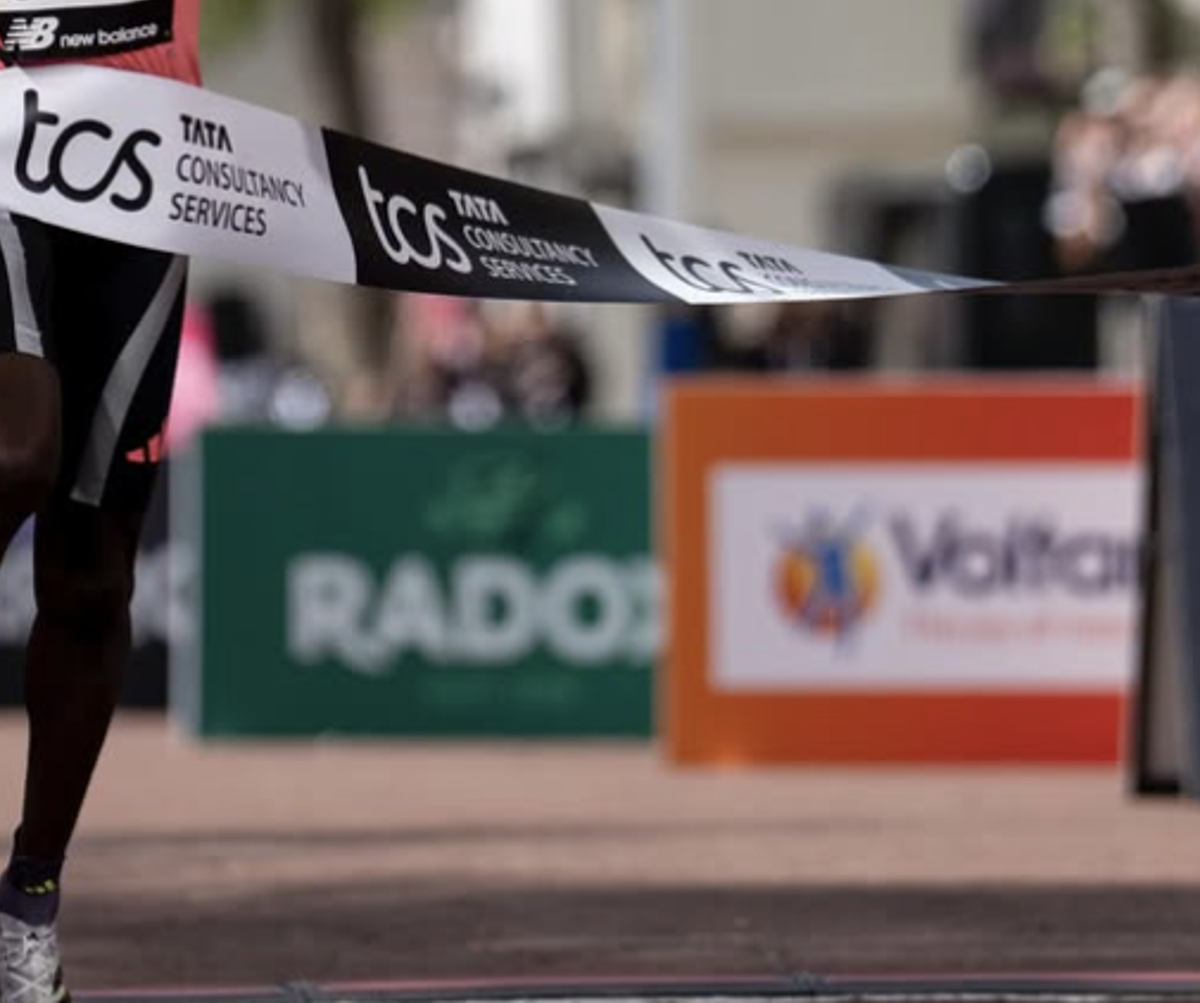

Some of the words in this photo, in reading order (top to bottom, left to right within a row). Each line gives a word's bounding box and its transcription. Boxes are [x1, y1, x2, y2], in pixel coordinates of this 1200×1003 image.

[60, 32, 96, 47] new
[97, 23, 158, 45] balance
[15, 89, 161, 211] tcs
[180, 114, 233, 153] TATA
[176, 154, 305, 207] CONSULTANCY
[169, 193, 267, 236] SERVICES
[358, 165, 473, 274] tcs
[447, 190, 509, 226] TATA
[463, 225, 599, 268] CONSULTANCY
[480, 256, 578, 286] SERVICES
